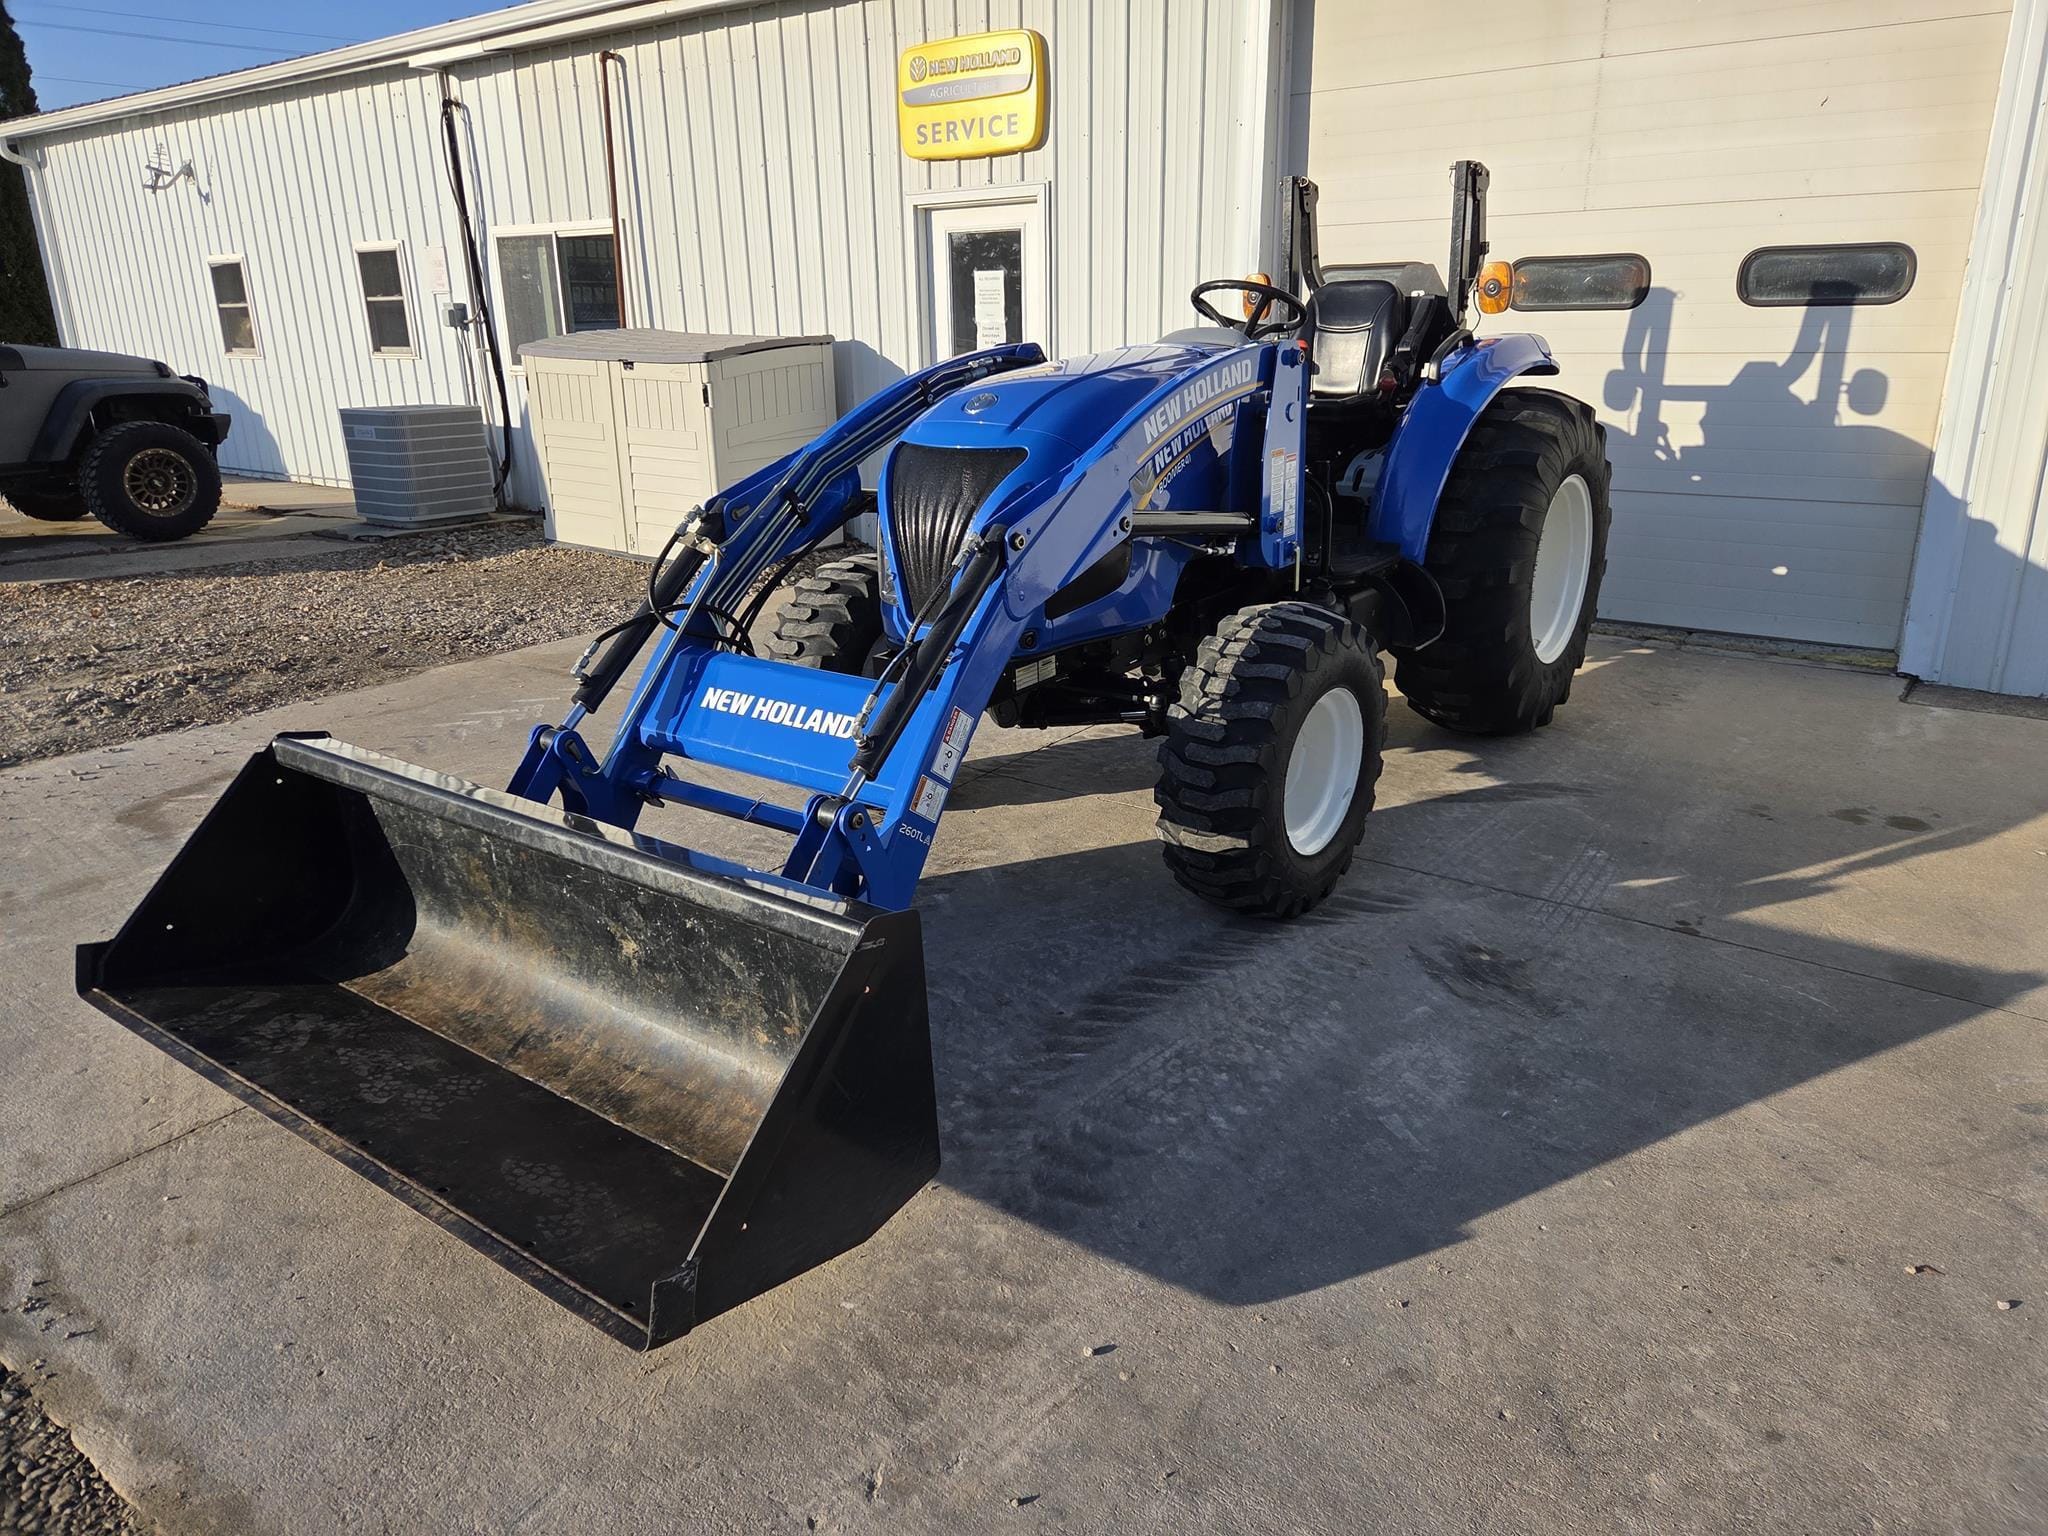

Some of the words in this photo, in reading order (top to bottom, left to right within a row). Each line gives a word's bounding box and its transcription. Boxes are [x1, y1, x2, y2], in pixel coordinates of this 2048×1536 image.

[929, 56, 958, 76] NEW
[960, 47, 1020, 71] HOLLAND
[930, 80, 998, 98] AGRICULT
[916, 113, 1018, 145] SERVICE
[1143, 394, 1181, 444] NEW
[1183, 359, 1251, 413] HOLLAND
[1154, 434, 1182, 474] NEW
[1158, 459, 1186, 494] BOOMER
[700, 687, 756, 716] NEW
[751, 697, 856, 739] HOLLAND
[899, 823, 931, 846] 260TLA
